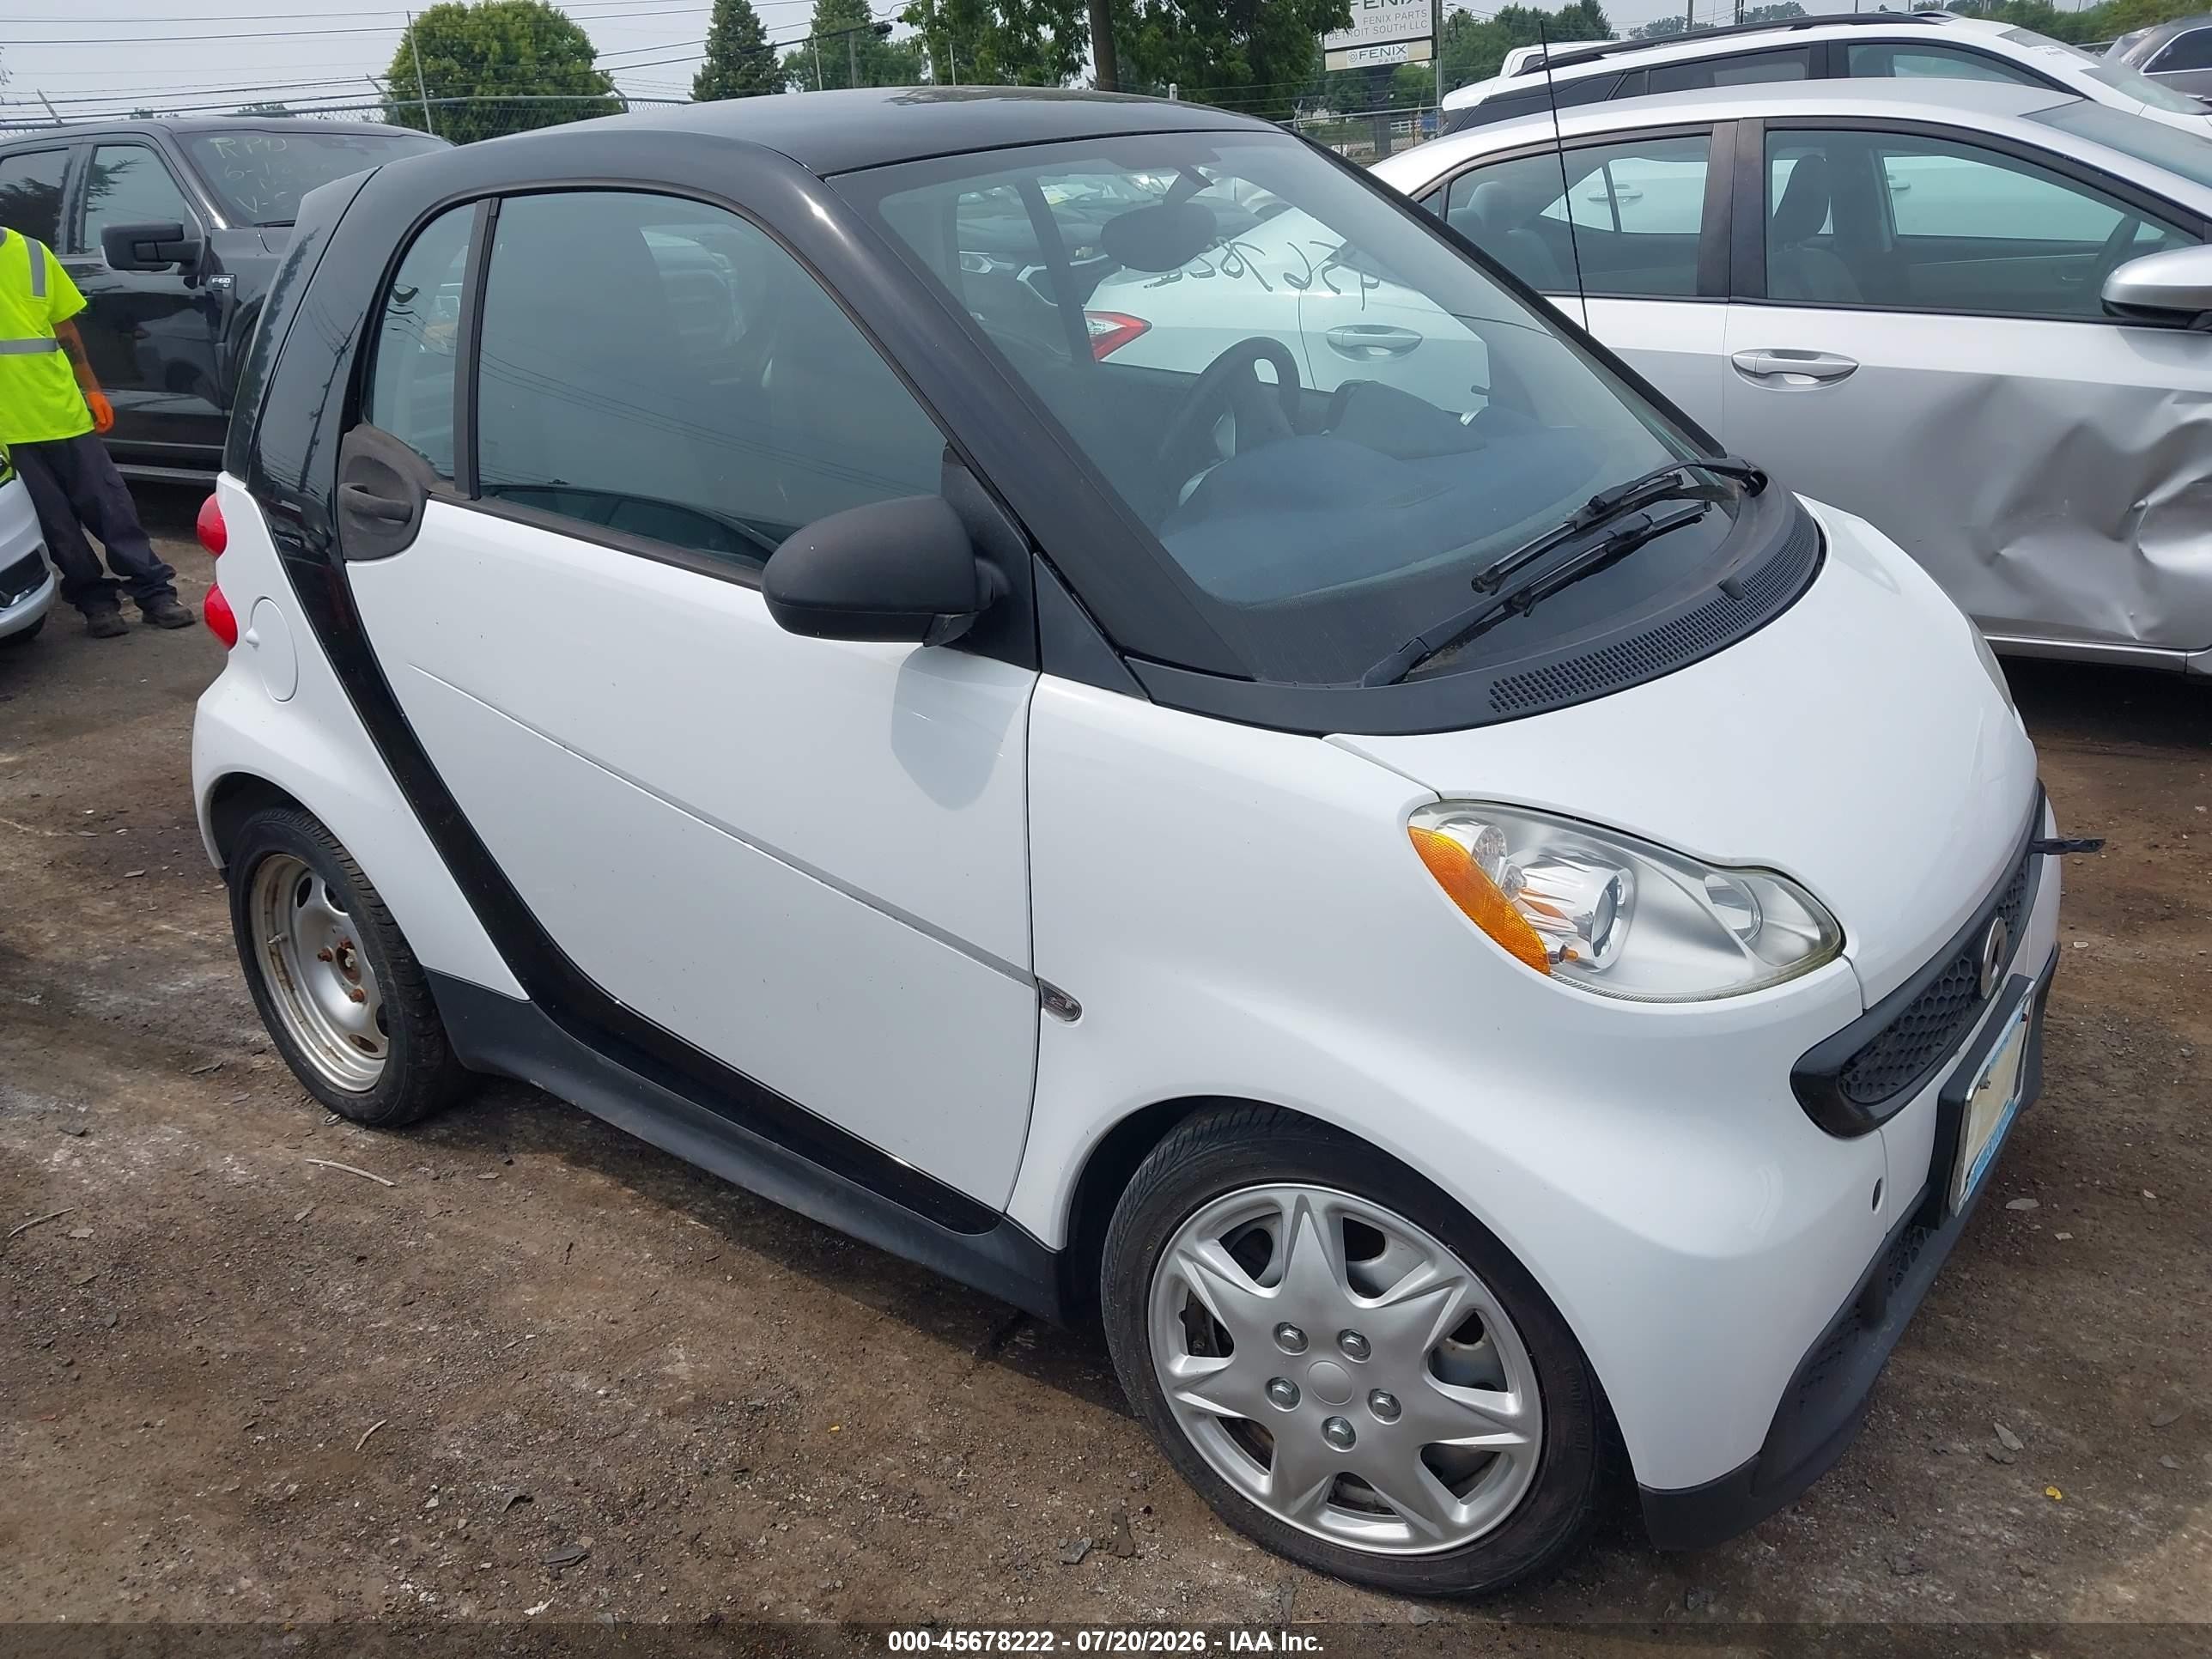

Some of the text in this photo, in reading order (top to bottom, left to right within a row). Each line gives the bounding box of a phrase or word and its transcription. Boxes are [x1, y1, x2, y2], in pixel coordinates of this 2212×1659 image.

[1363, 9, 1427, 25] FENIX PARTS
[1328, 20, 1428, 41] DETROIT SOUTH LLC
[1359, 45, 1407, 59] FENIX
